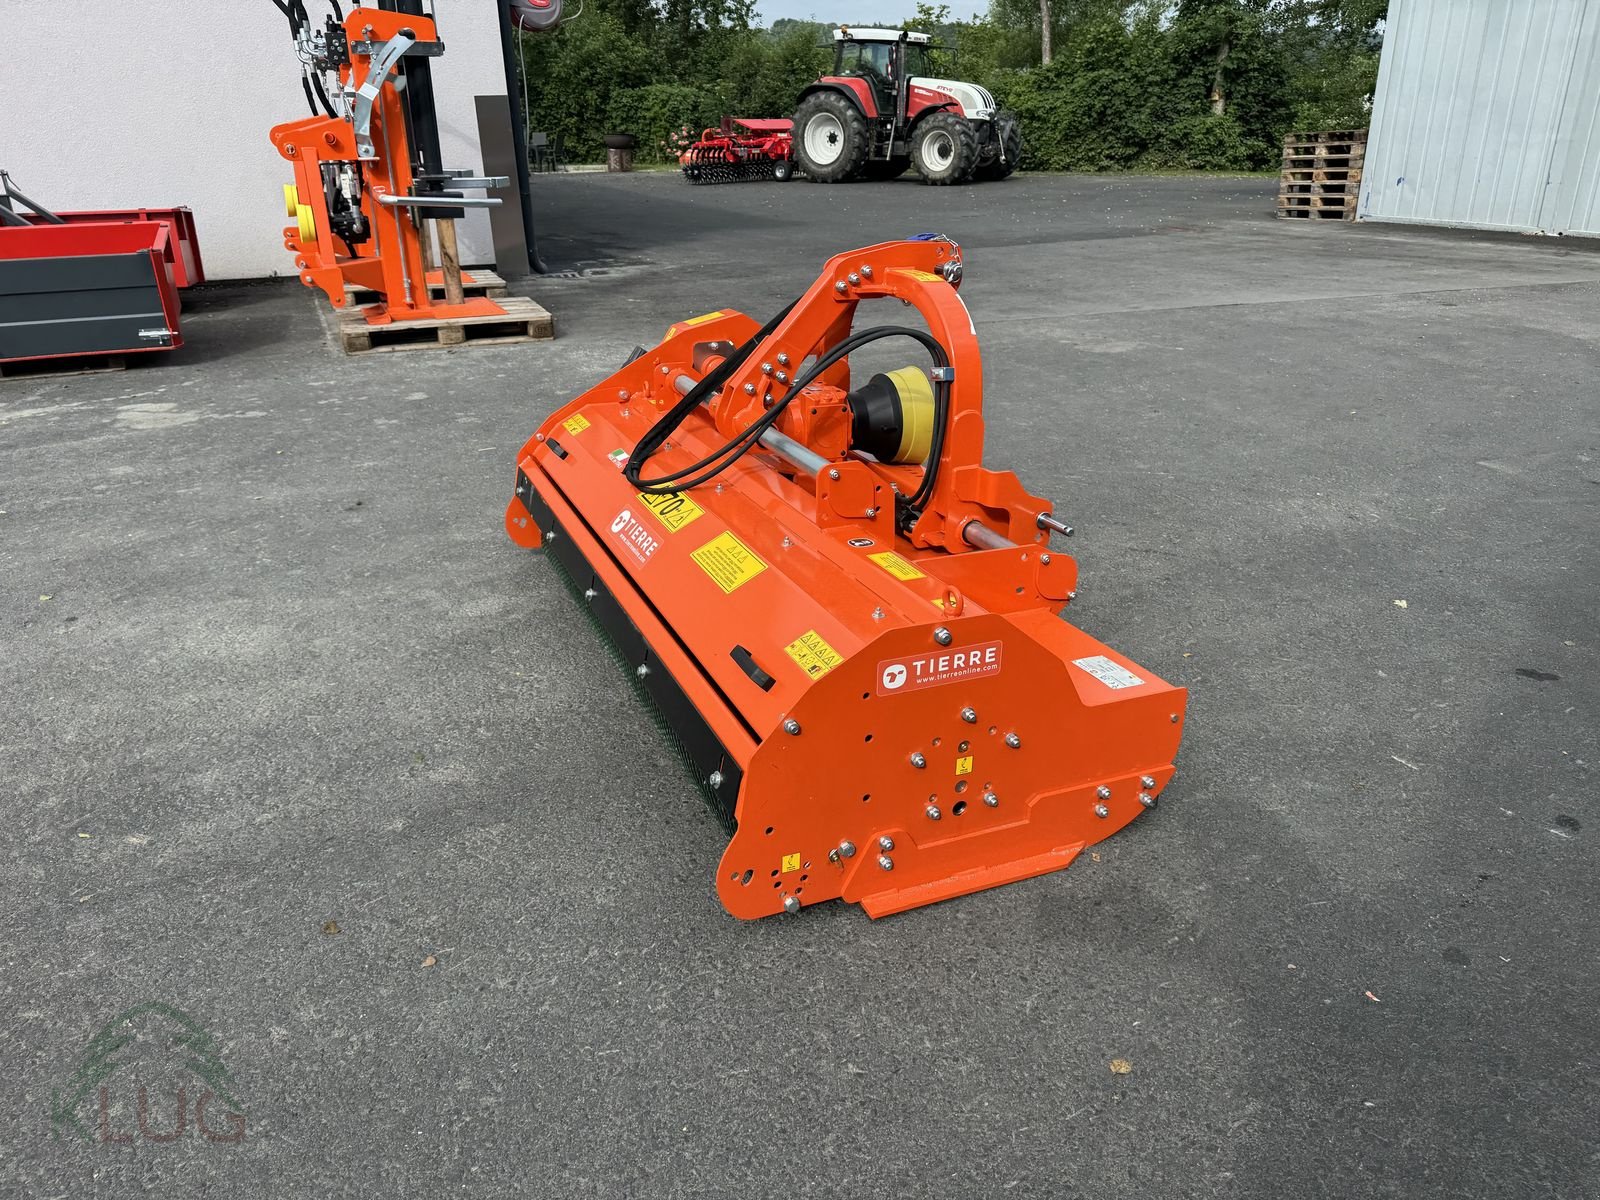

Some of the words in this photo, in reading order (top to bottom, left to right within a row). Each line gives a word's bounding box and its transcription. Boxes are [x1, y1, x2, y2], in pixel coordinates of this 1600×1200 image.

[624, 518, 659, 557] TIERRE
[912, 647, 997, 676] TIERRE
[916, 663, 998, 684] www.tierreonline.com
